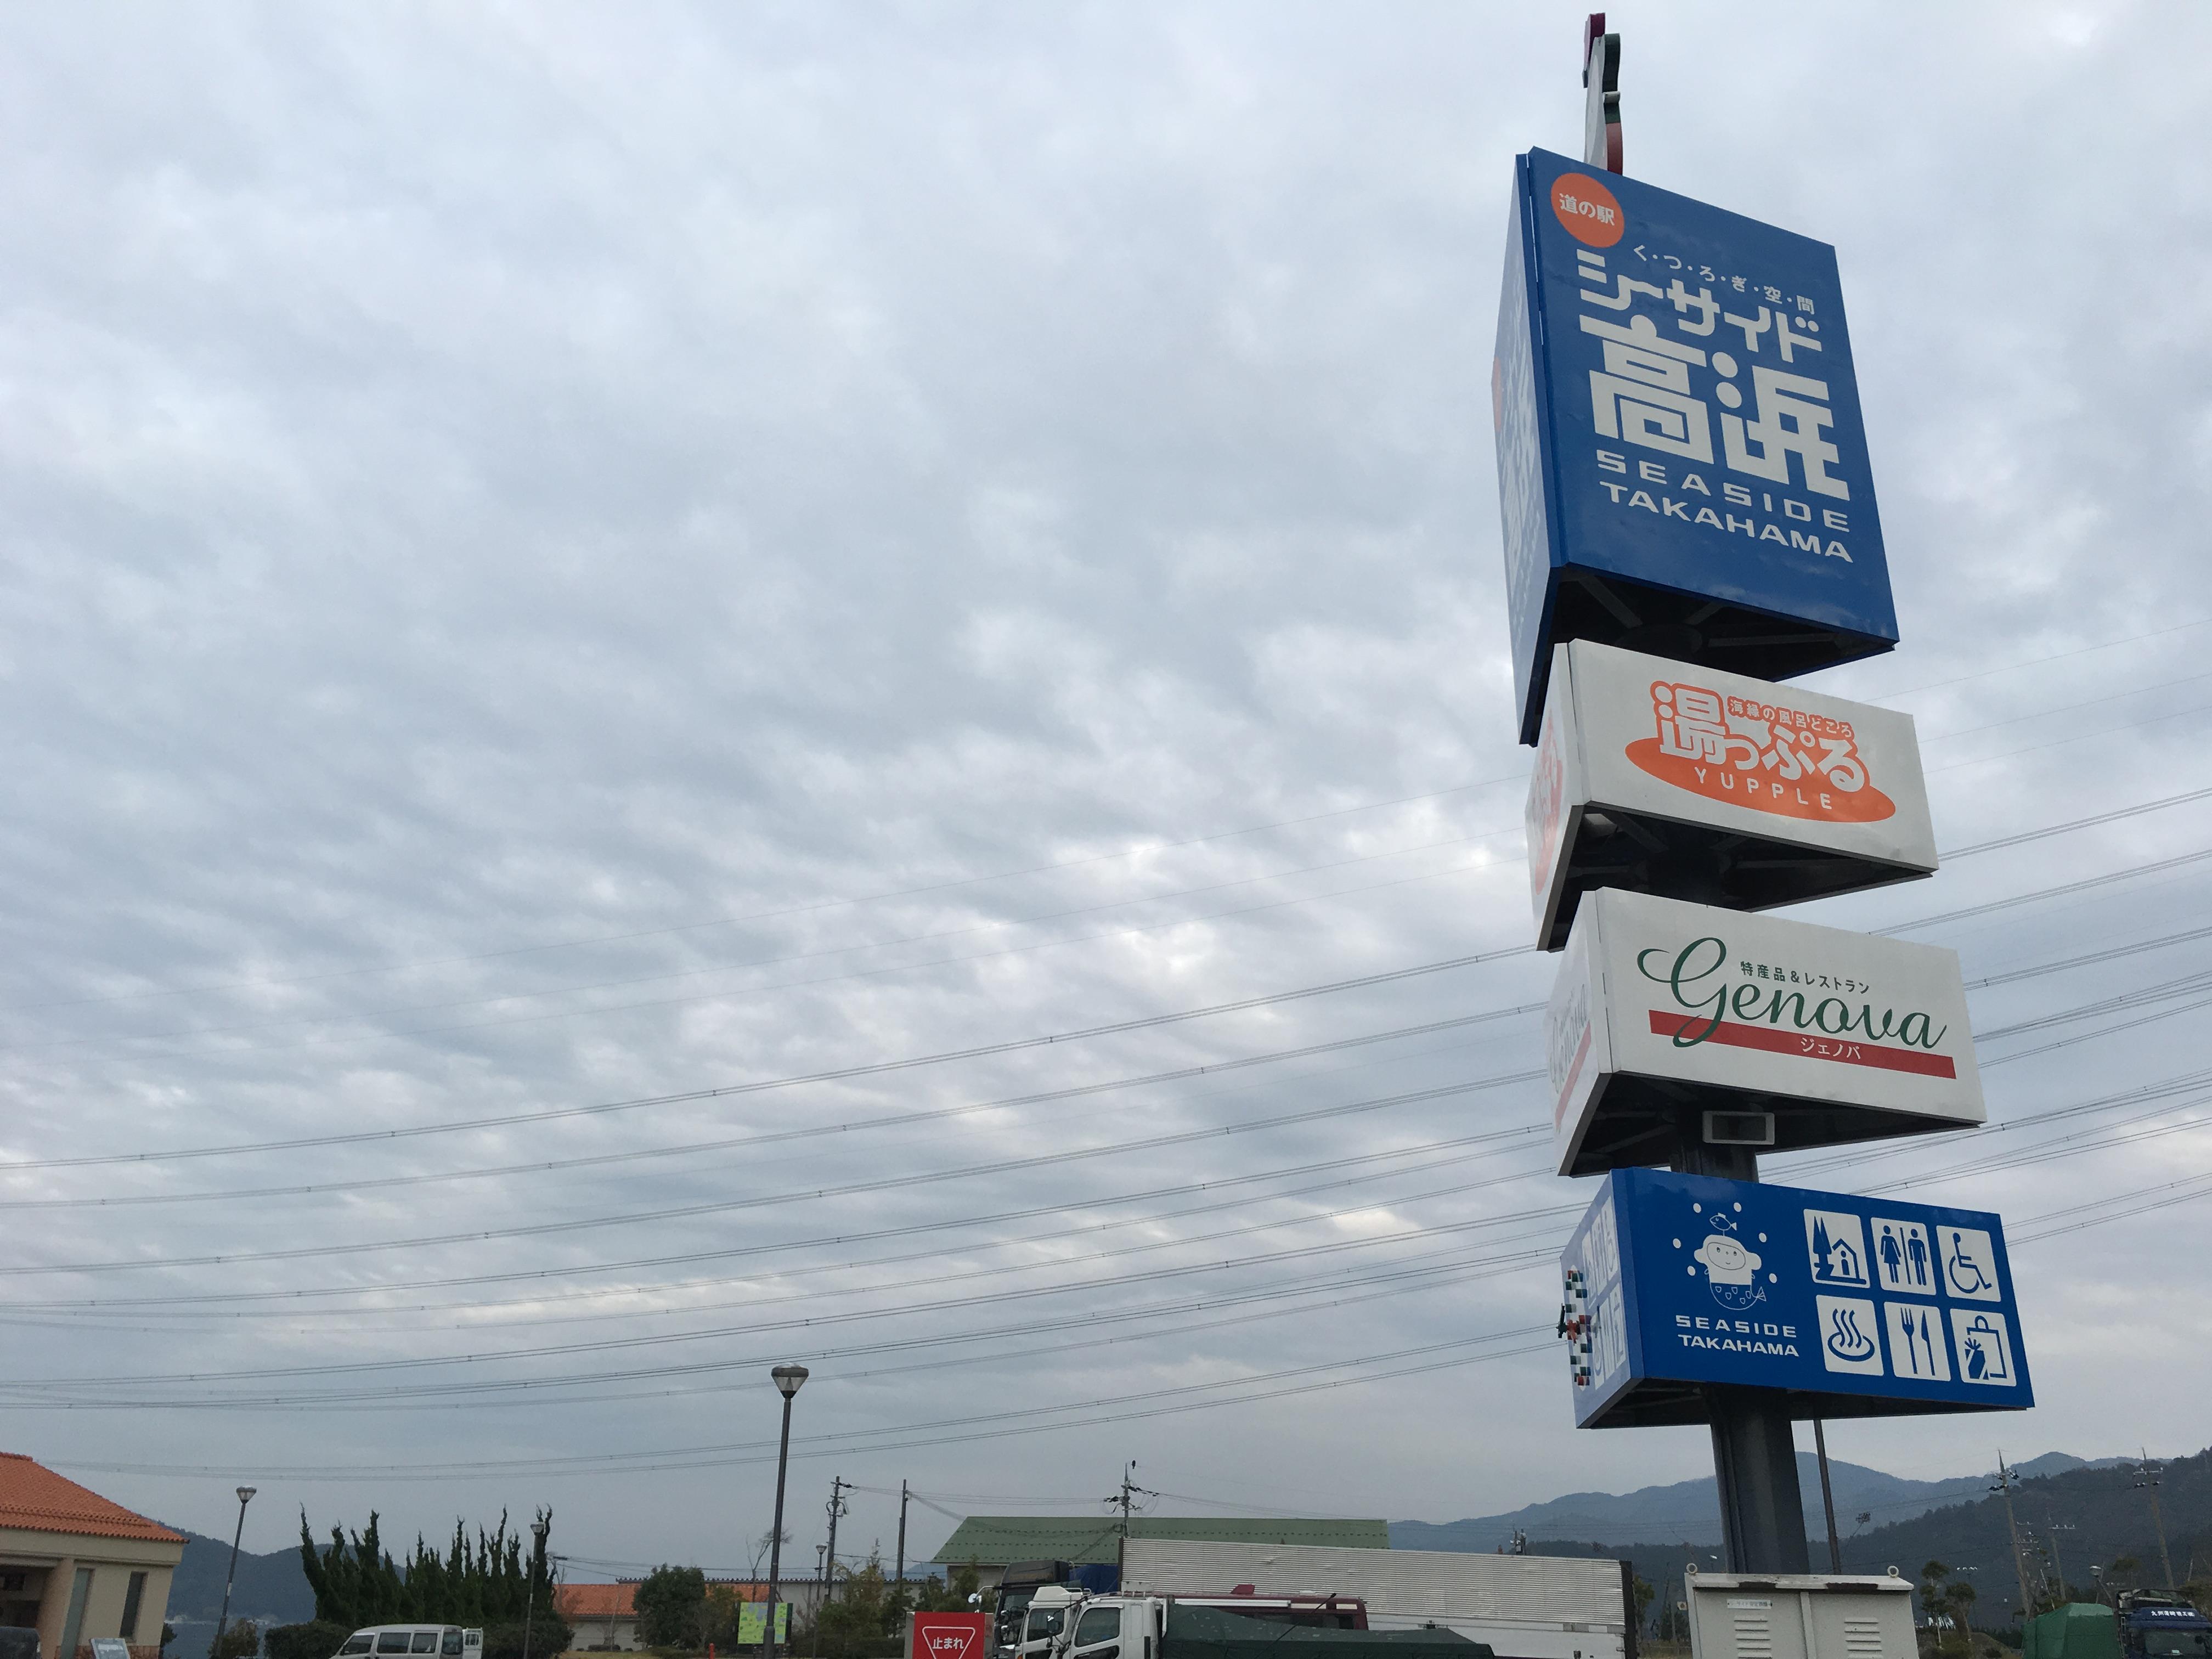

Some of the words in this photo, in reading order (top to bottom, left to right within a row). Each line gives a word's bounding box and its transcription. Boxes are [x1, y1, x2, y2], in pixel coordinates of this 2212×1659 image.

[1559, 193, 1615, 226] 道の駅
[1576, 249, 1822, 363] シーサイド
[1579, 314, 1850, 501] 高浜
[1596, 449, 1850, 533] SEASIDE
[1599, 481, 1854, 563] TAKAHAMA
[1652, 682, 1867, 794] 湯っぷる
[1694, 766, 1832, 810] YUPPLE
[1637, 937, 1948, 1048] Genova
[1801, 1037, 1861, 1059] ジェノバ
[1675, 1314, 1797, 1338] SEASIDE
[1677, 1334, 1799, 1357] TAKAHAMA
[932, 1637, 964, 1650] 止まれ
